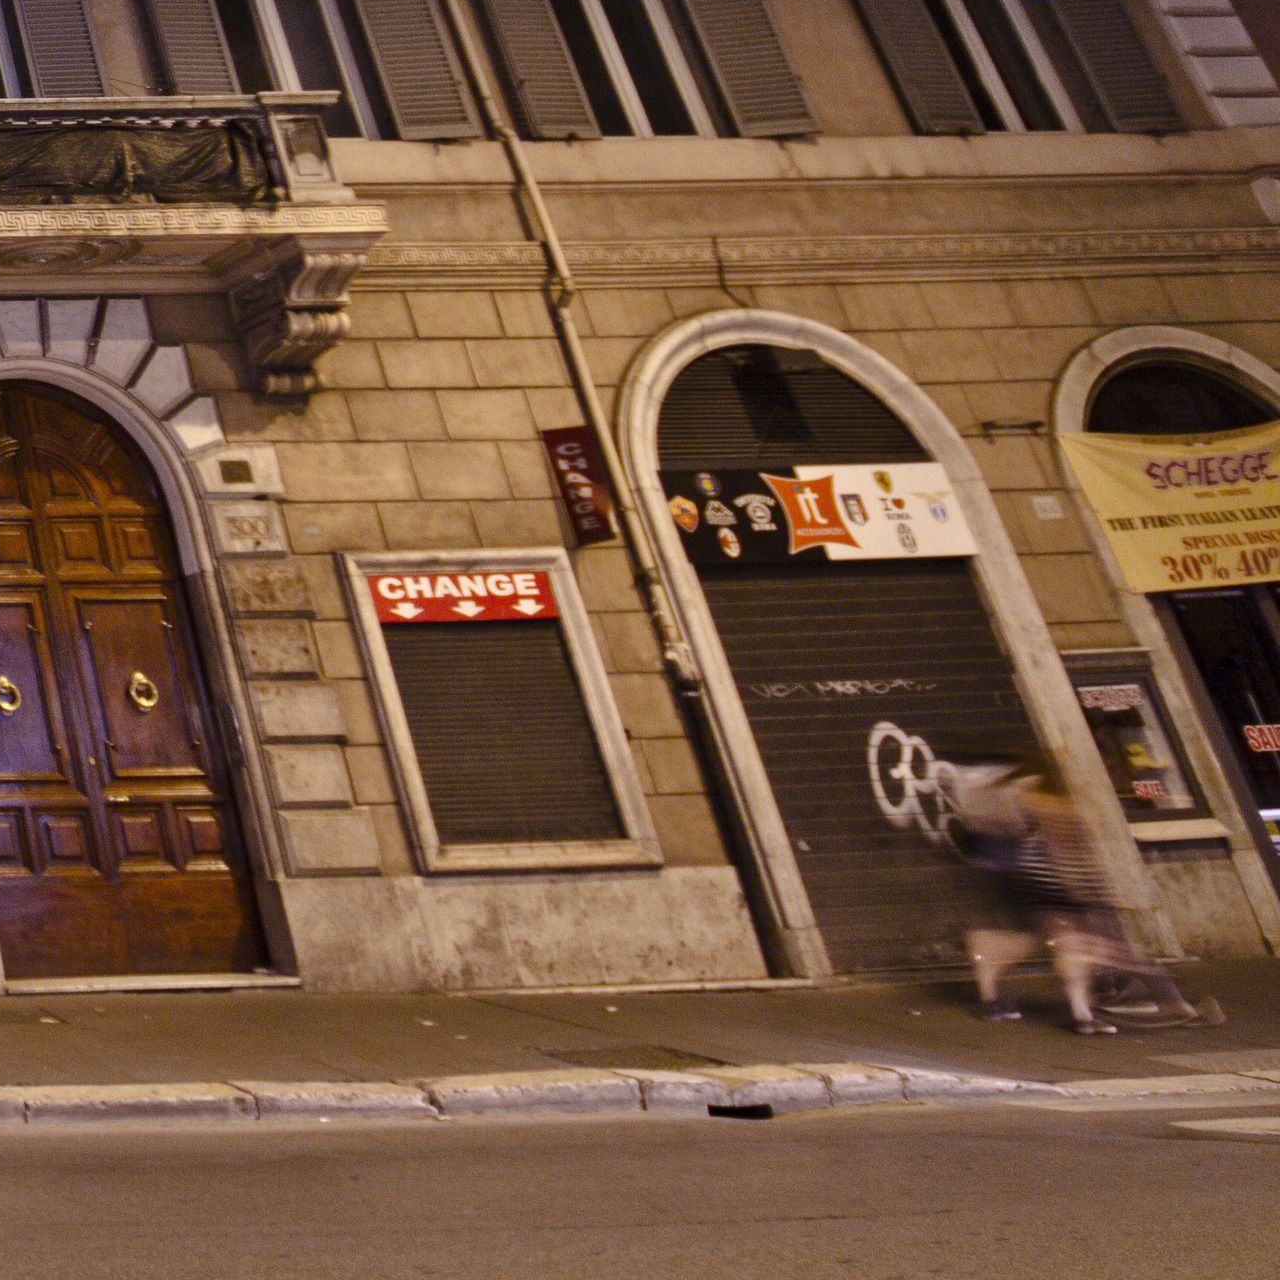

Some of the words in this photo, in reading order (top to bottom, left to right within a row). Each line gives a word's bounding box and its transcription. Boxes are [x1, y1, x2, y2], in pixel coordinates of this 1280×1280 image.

[1145, 451, 1280, 490] SCHEGGE
[1107, 517, 1138, 532] THE
[1140, 514, 1186, 530] FIRST
[1185, 511, 1240, 526] ITALIAN
[1161, 552, 1230, 584] 30%
[377, 573, 540, 600] CHANGE
